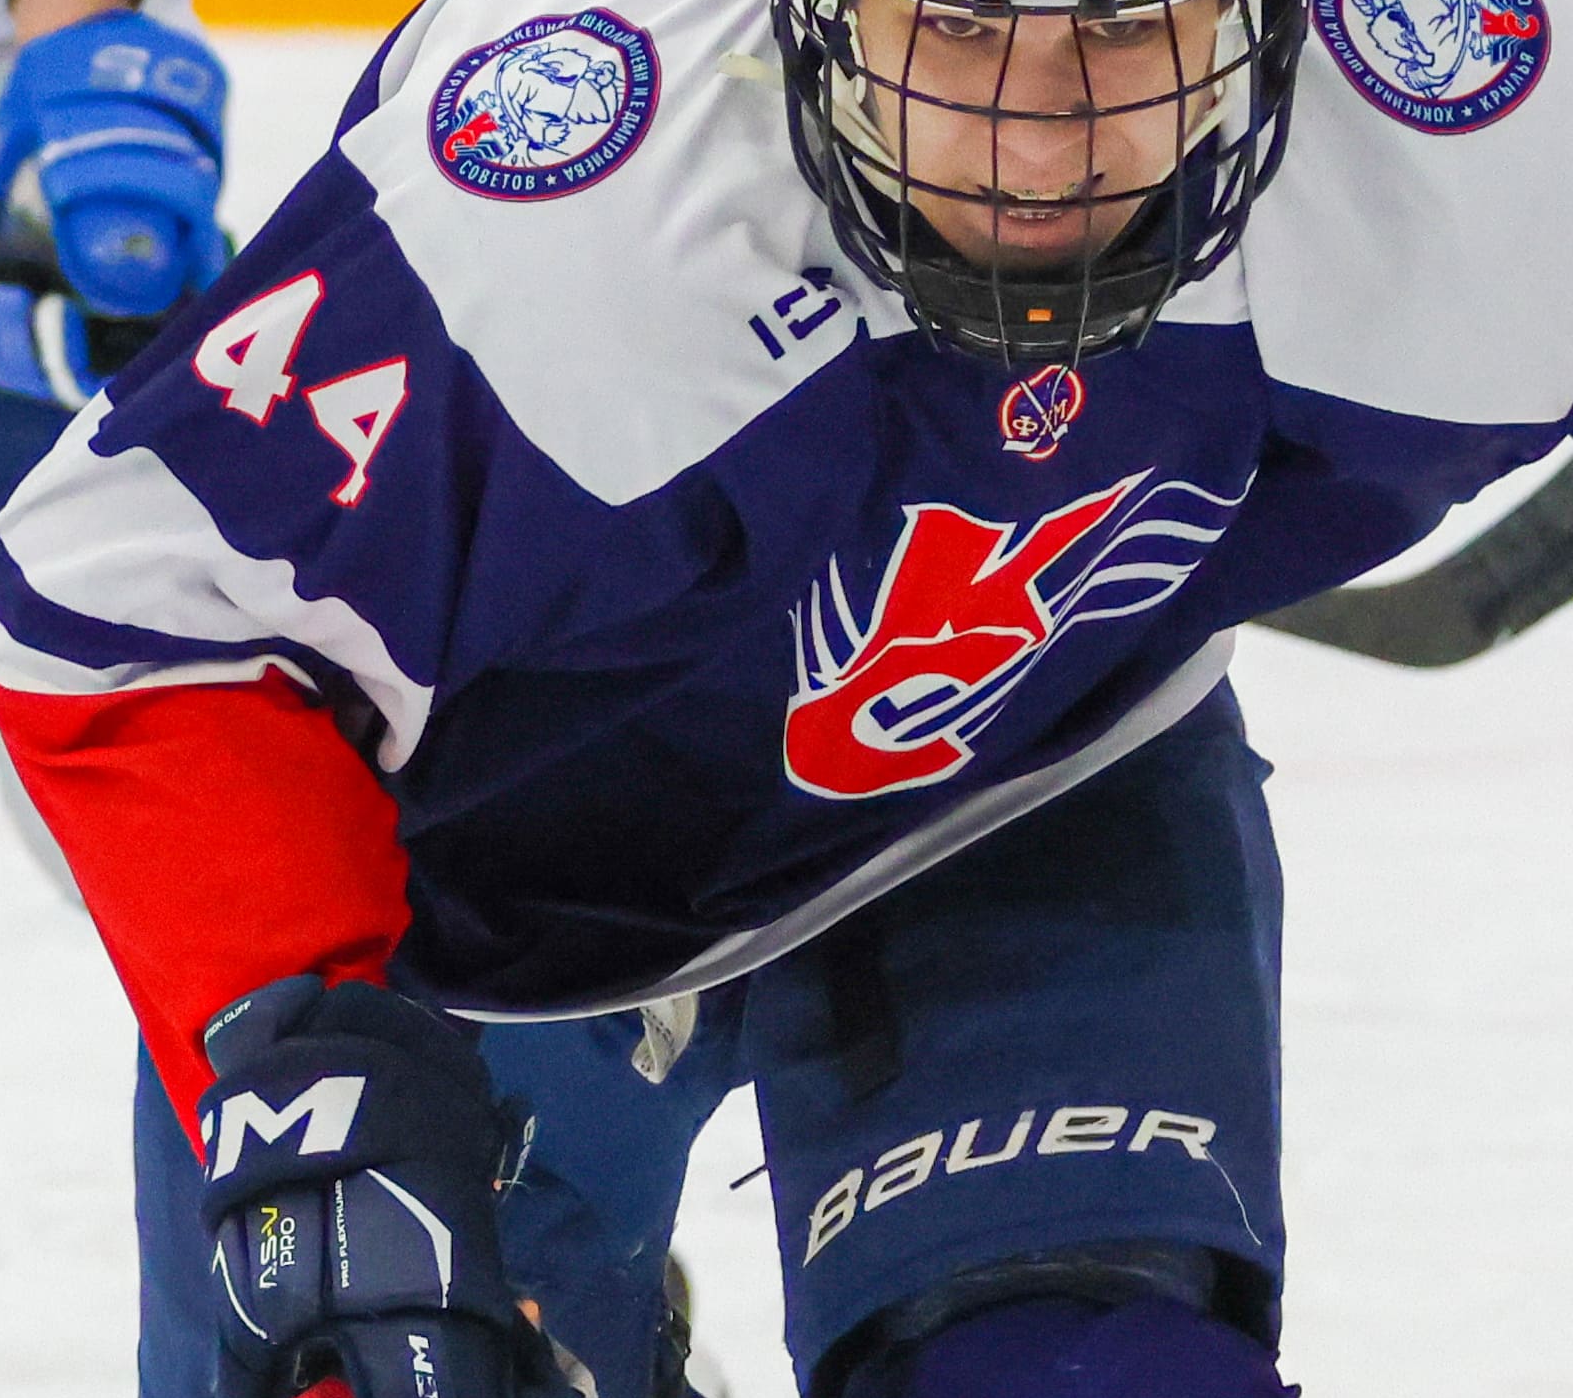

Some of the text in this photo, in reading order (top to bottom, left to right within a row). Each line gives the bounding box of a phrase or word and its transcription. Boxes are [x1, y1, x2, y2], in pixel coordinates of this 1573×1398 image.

[1479, 52, 1535, 113] КРЫЛЬЯ
[458, 159, 537, 191] СОВЕТОВ
[200, 1075, 367, 1183] M
[279, 1216, 296, 1267] PRO
[340, 1259, 350, 1289] PRO
